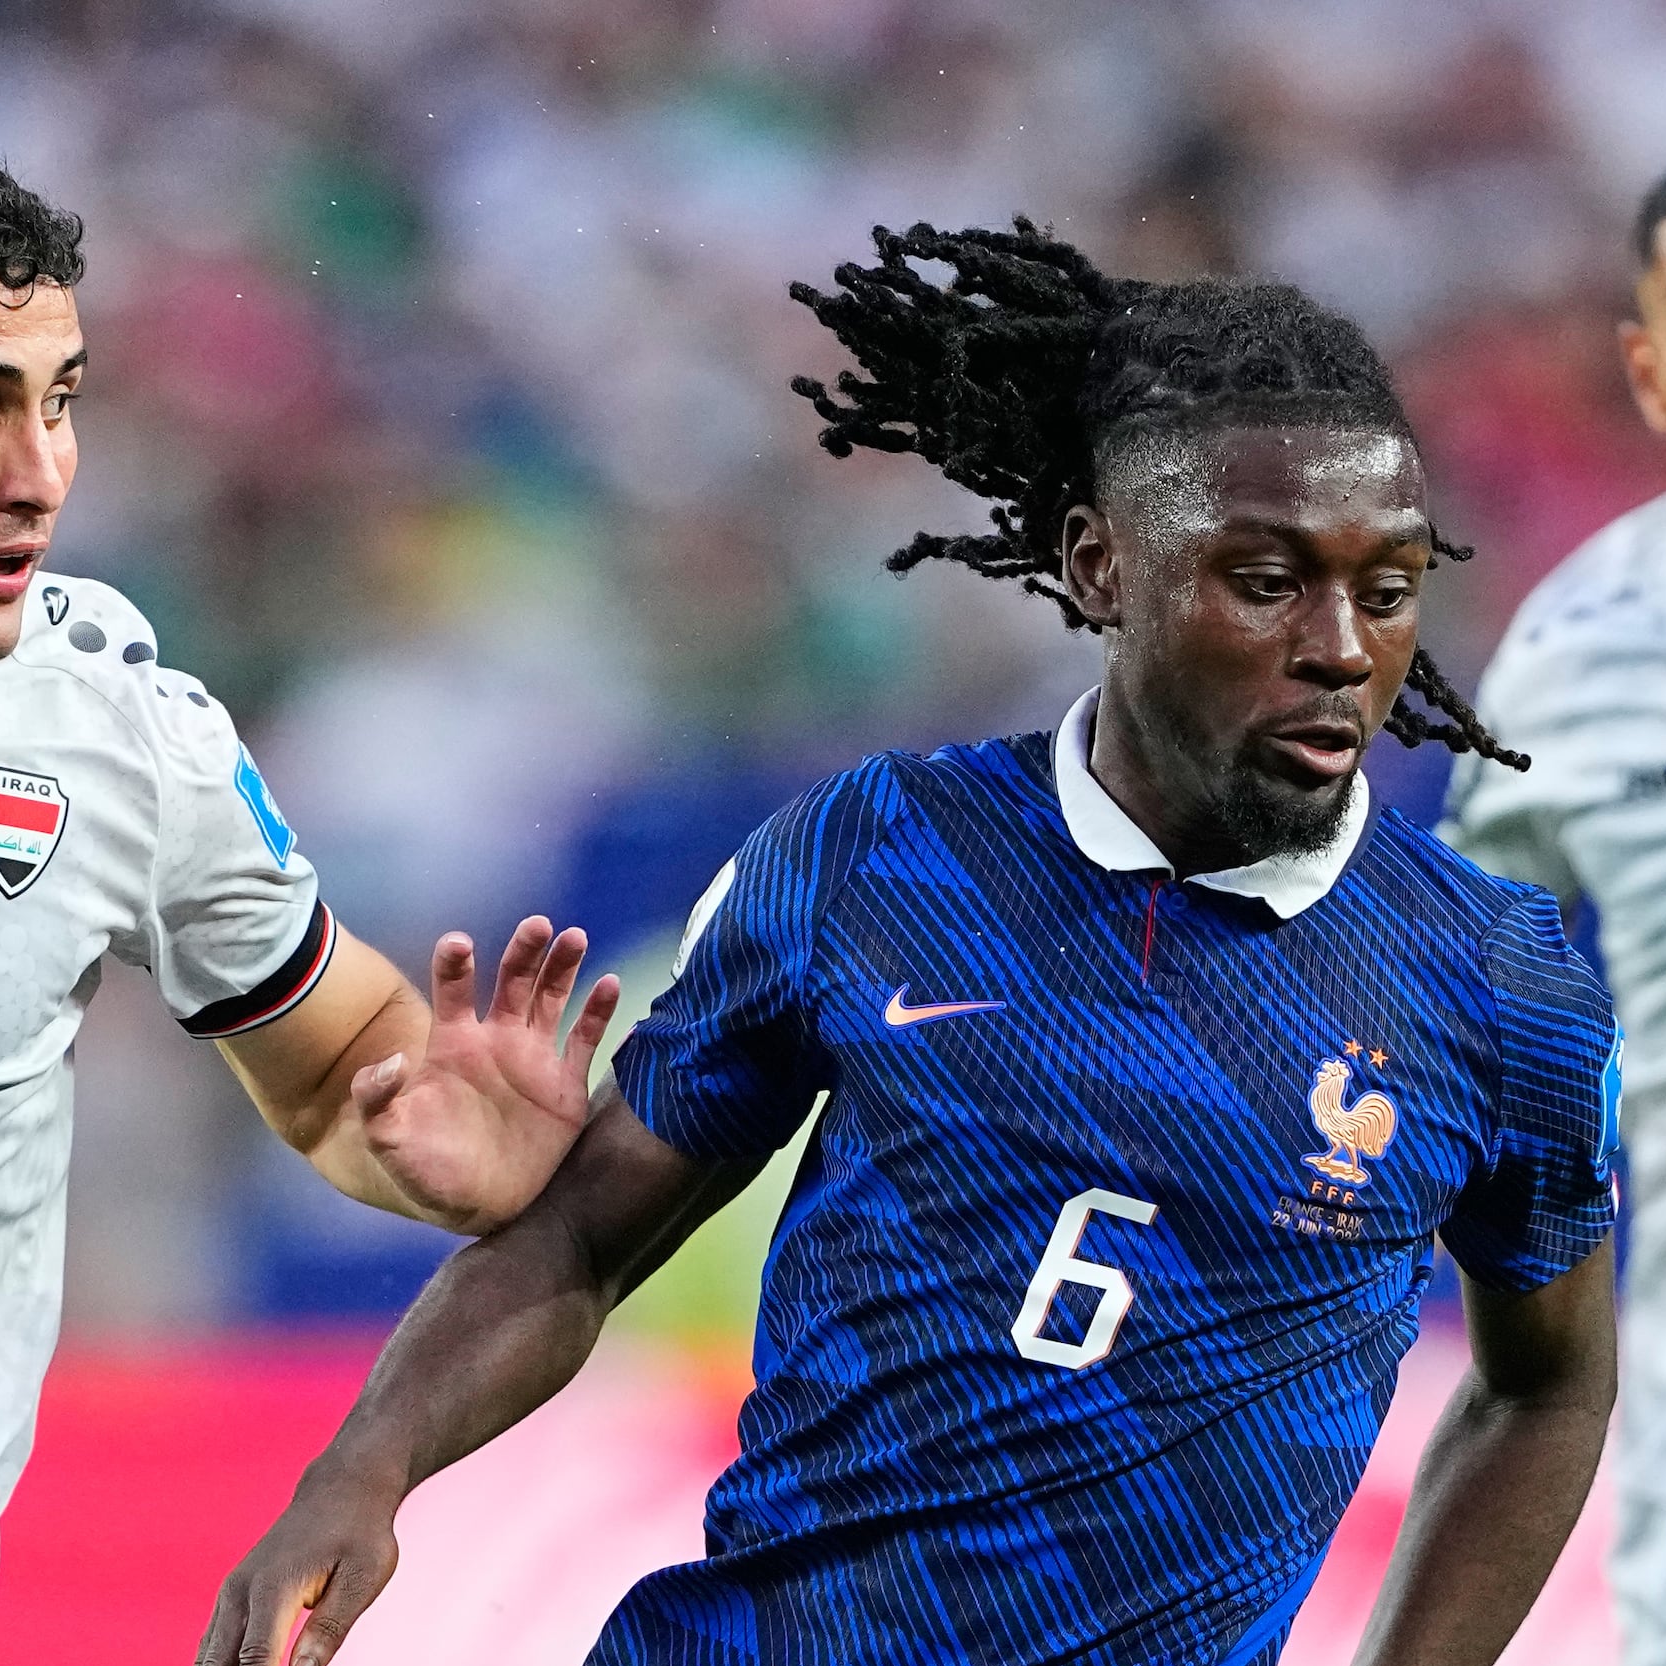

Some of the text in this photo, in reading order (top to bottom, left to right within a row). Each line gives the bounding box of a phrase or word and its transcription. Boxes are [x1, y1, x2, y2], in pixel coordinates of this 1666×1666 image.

[1, 776, 52, 798] IRAQ
[1277, 1195, 1325, 1220] FRANCE
[1336, 1211, 1365, 1233] IRAK
[1293, 1217, 1322, 1237] JUIN
[1010, 1187, 1160, 1370] 6
